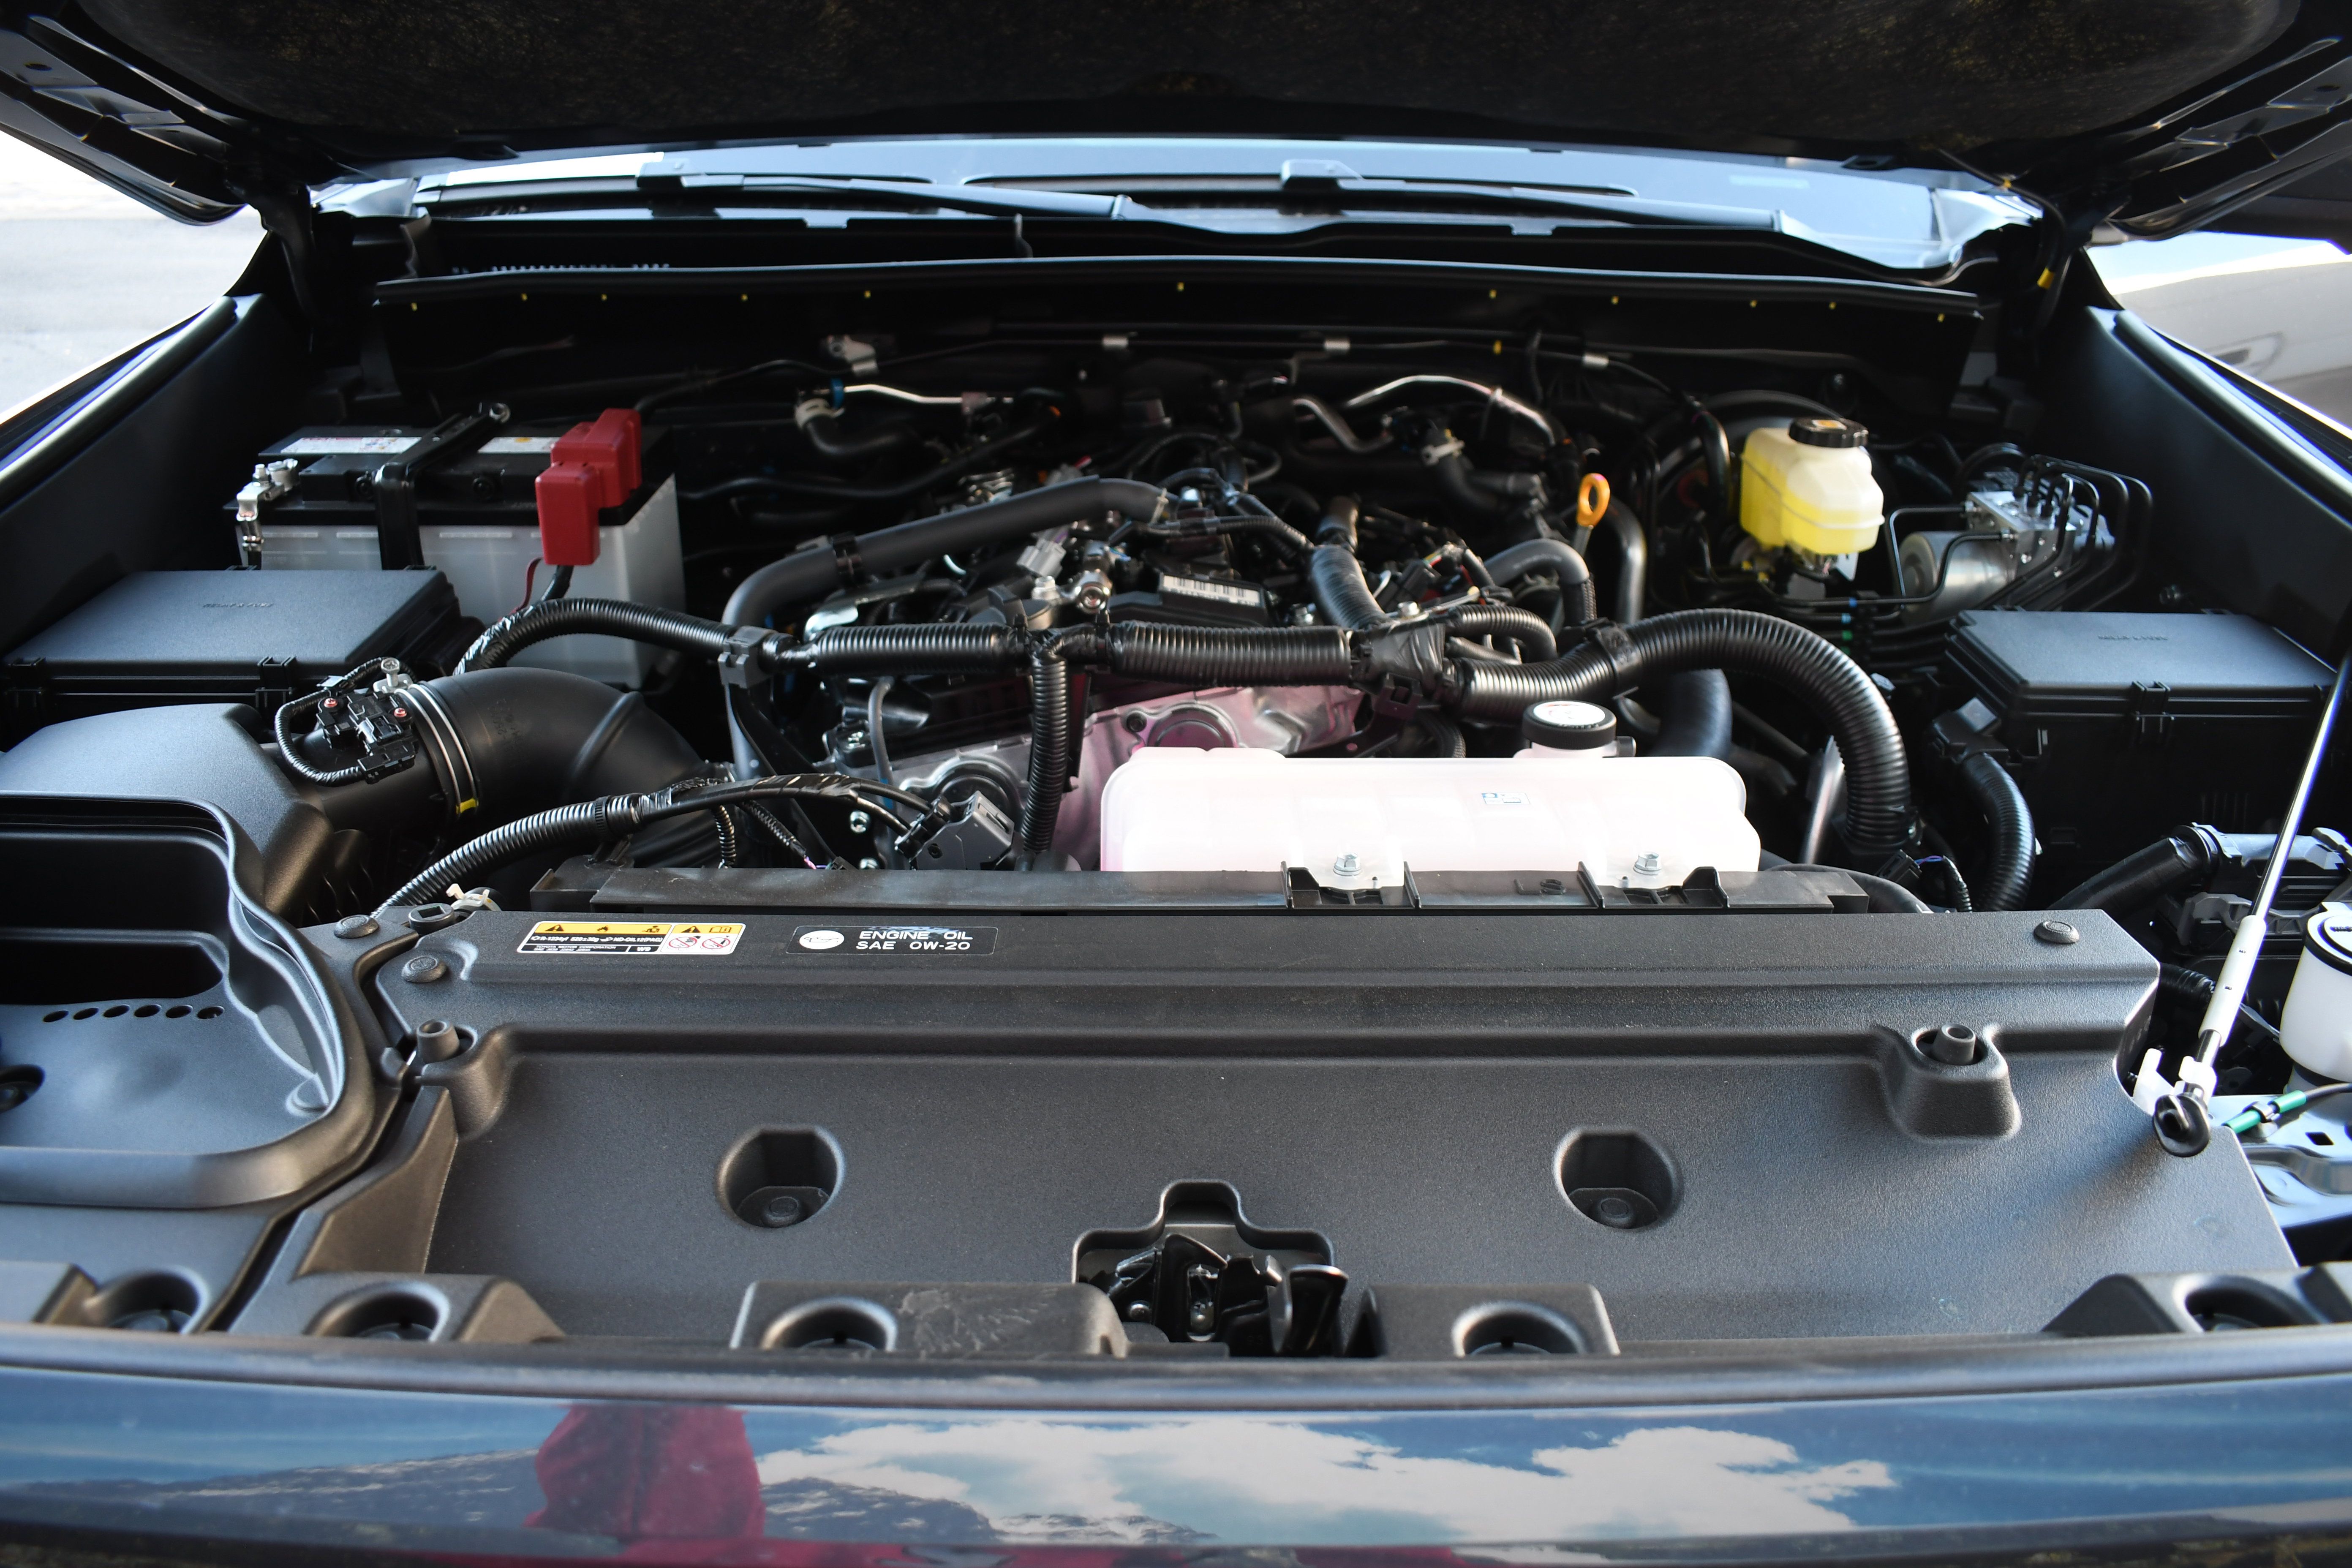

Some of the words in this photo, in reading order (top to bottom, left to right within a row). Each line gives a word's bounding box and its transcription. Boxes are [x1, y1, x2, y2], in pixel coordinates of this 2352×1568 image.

[859, 931, 931, 940] ENGINE
[943, 931, 973, 940] OIL
[855, 941, 897, 950] SAE
[909, 941, 971, 950] 0W-20
